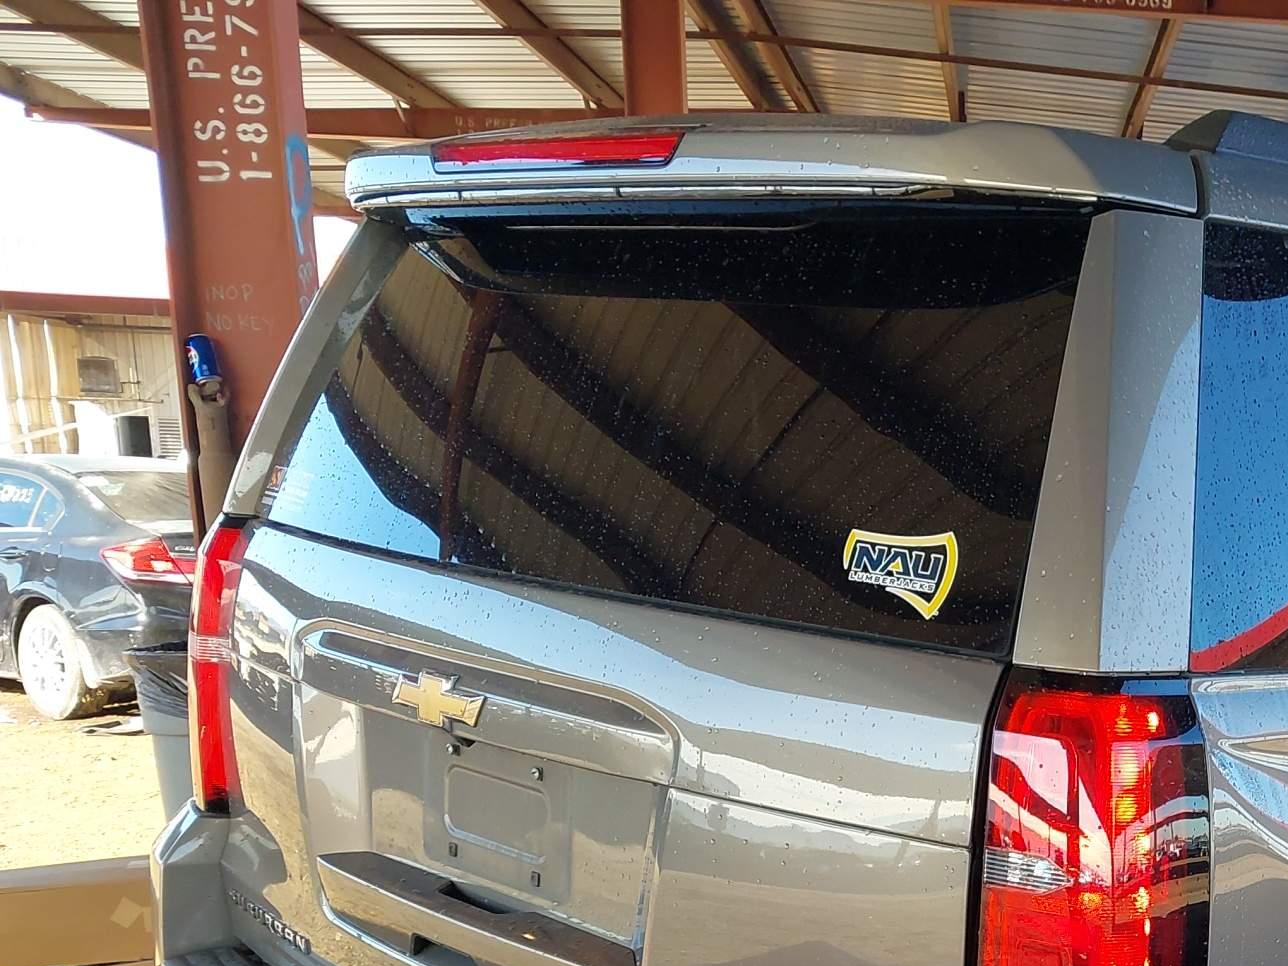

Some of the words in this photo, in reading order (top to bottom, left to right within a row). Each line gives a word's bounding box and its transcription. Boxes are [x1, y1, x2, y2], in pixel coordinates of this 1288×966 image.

[193, 107, 231, 182] U.S.
[848, 571, 936, 593] LUMBERJACKS
[851, 543, 944, 583] NAU
